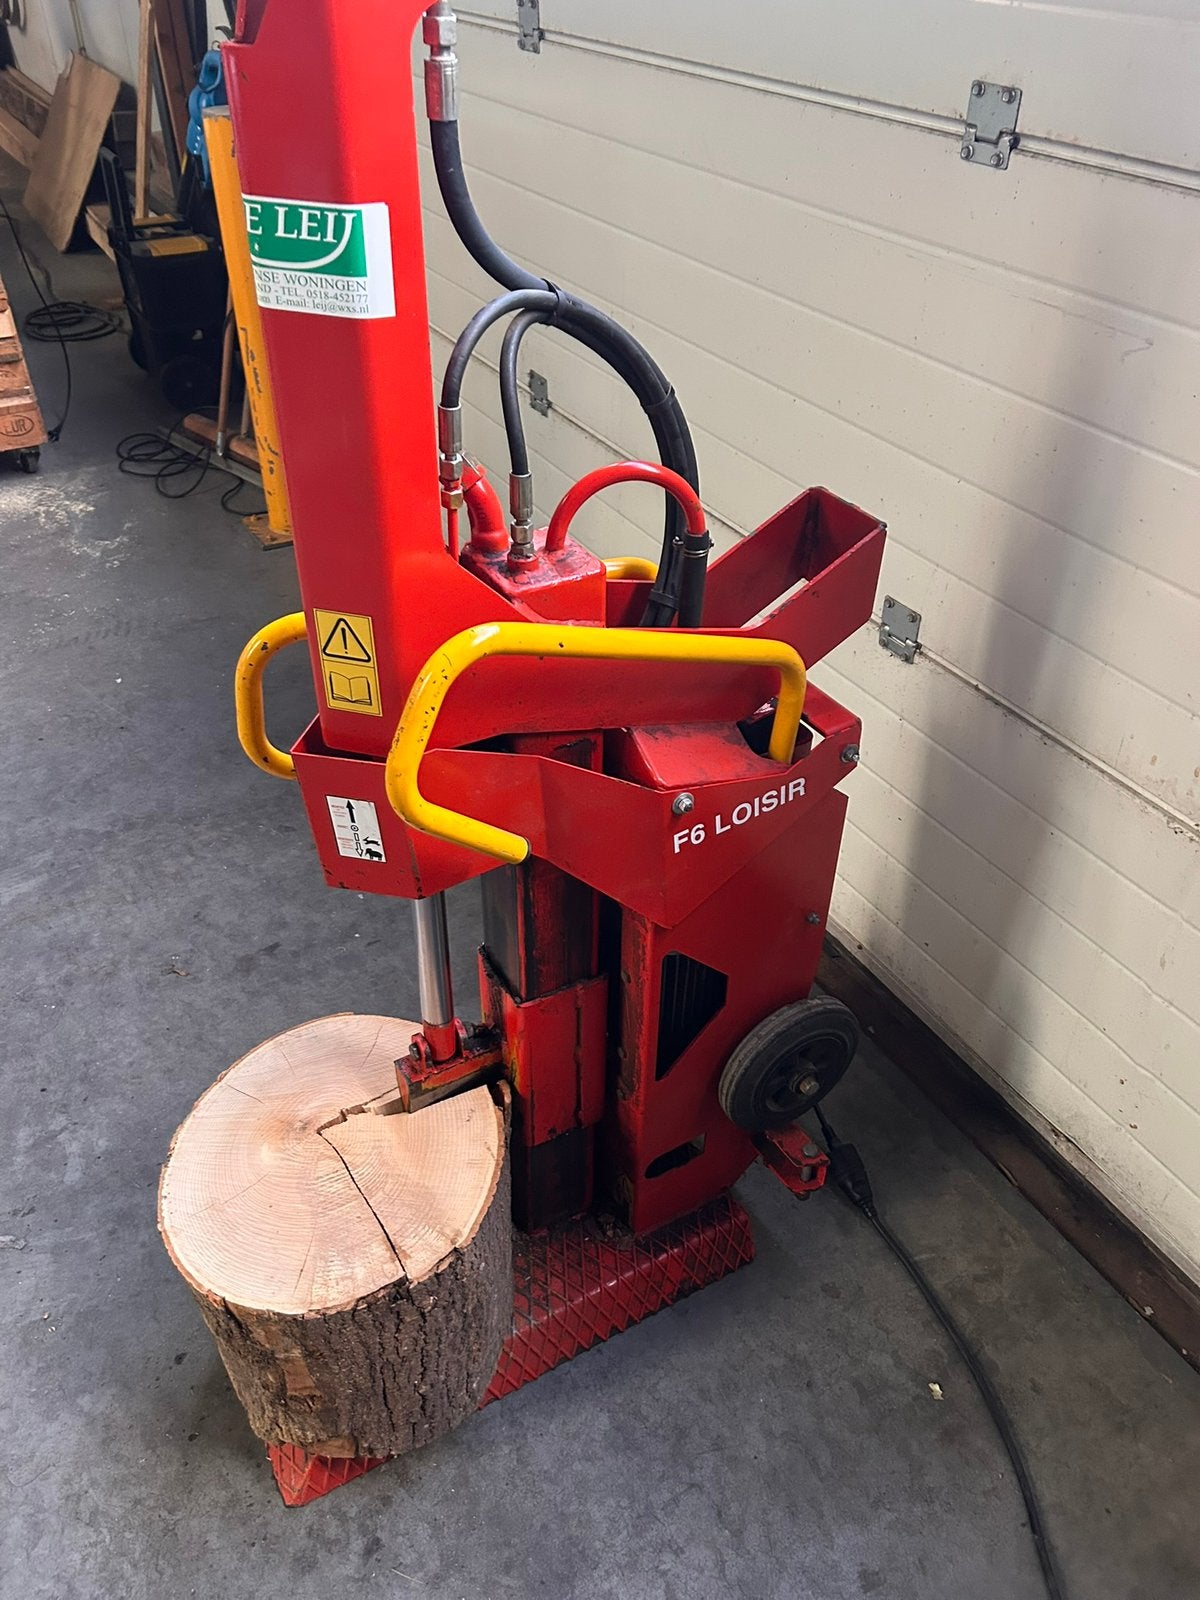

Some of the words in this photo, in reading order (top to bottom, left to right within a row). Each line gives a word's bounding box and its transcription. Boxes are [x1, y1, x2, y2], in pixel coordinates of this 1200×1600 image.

[243, 202, 262, 235] E
[274, 206, 357, 248] LEIJ
[283, 273, 367, 292] WONINGEN
[275, 295, 310, 308] E-mail:
[312, 299, 369, 313] leij@wxs.nl
[280, 286, 305, 297] TEL.
[306, 289, 368, 303] 0518-452177
[673, 823, 706, 854] F6
[715, 777, 806, 835] LOISIR
